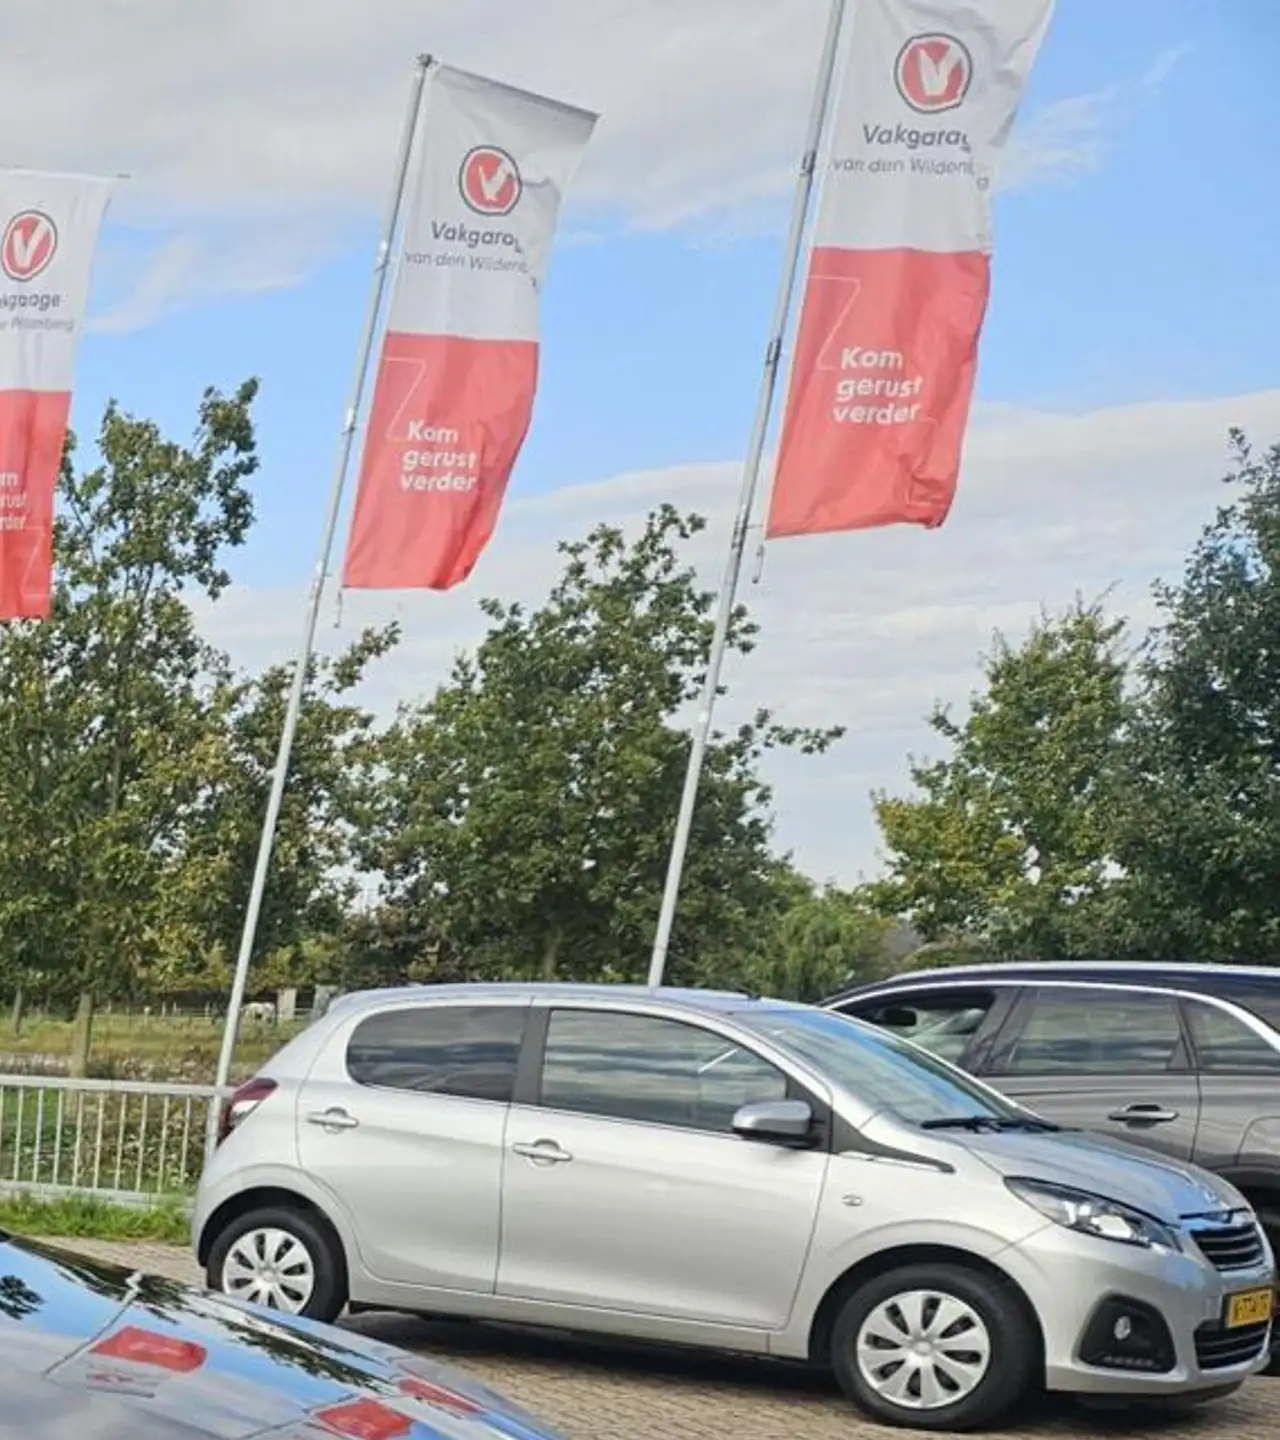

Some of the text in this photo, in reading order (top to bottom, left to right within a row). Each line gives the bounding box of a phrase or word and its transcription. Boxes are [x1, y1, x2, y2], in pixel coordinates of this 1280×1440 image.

[842, 346, 904, 369] Kom
[836, 376, 923, 401] gerust
[833, 404, 922, 425] verder
[407, 420, 458, 443] Kom
[402, 450, 476, 471] gerust
[400, 473, 476, 492] verder
